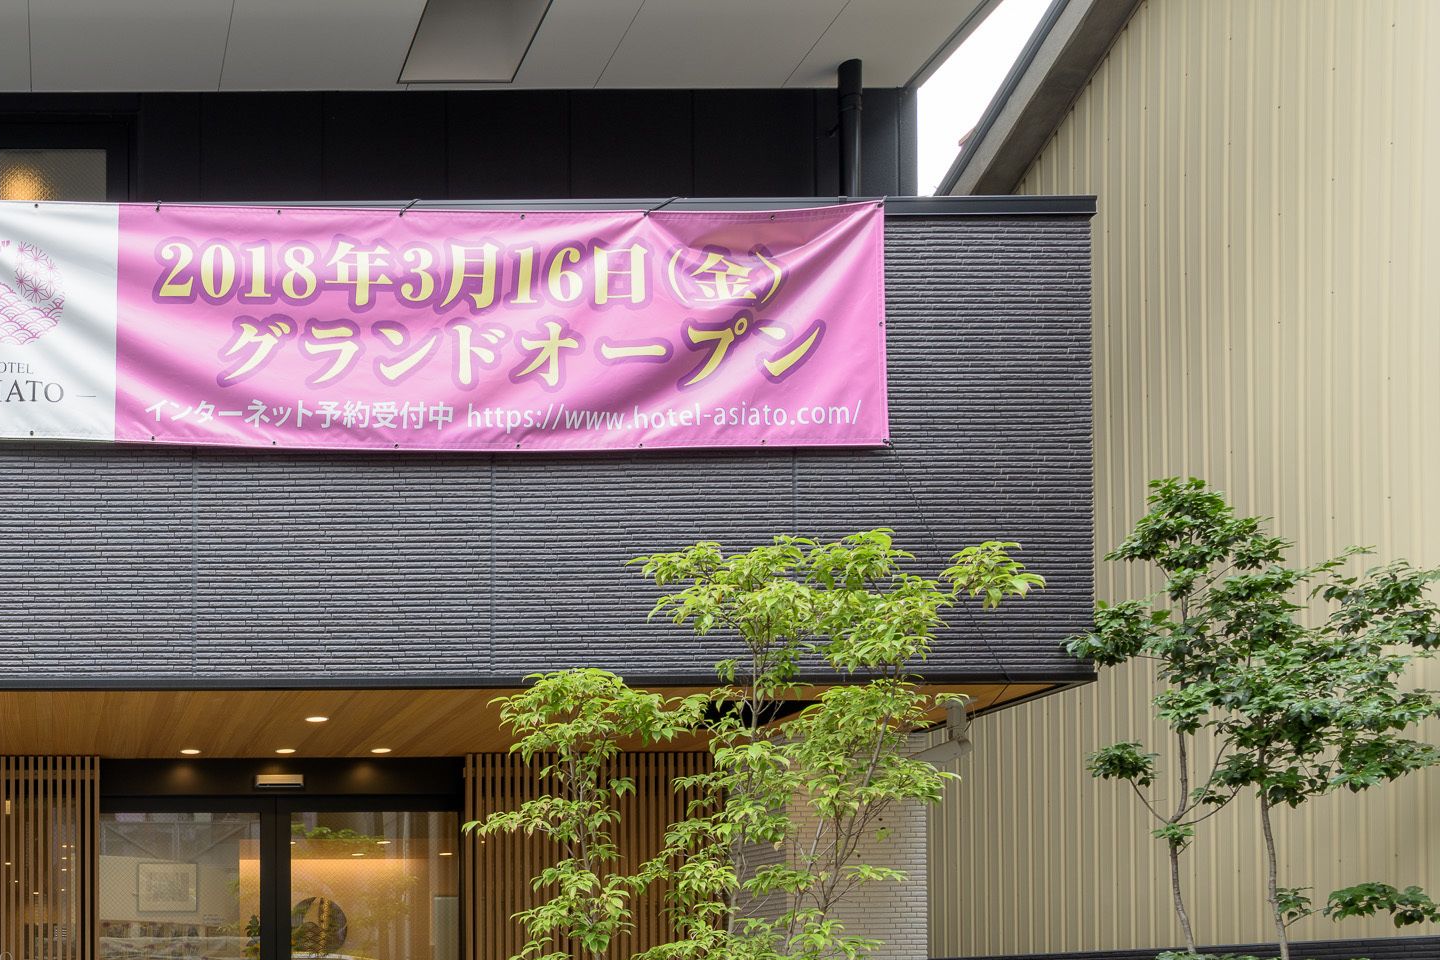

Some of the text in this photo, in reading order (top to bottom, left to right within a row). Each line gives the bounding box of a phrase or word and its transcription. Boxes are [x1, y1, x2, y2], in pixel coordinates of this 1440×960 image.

[157, 240, 785, 309] 2018年3月16日(金)
[222, 316, 822, 388] グランドオープン
[144, 398, 862, 433] インターネット予約受付中 https://www.hotel-asiato.com/
